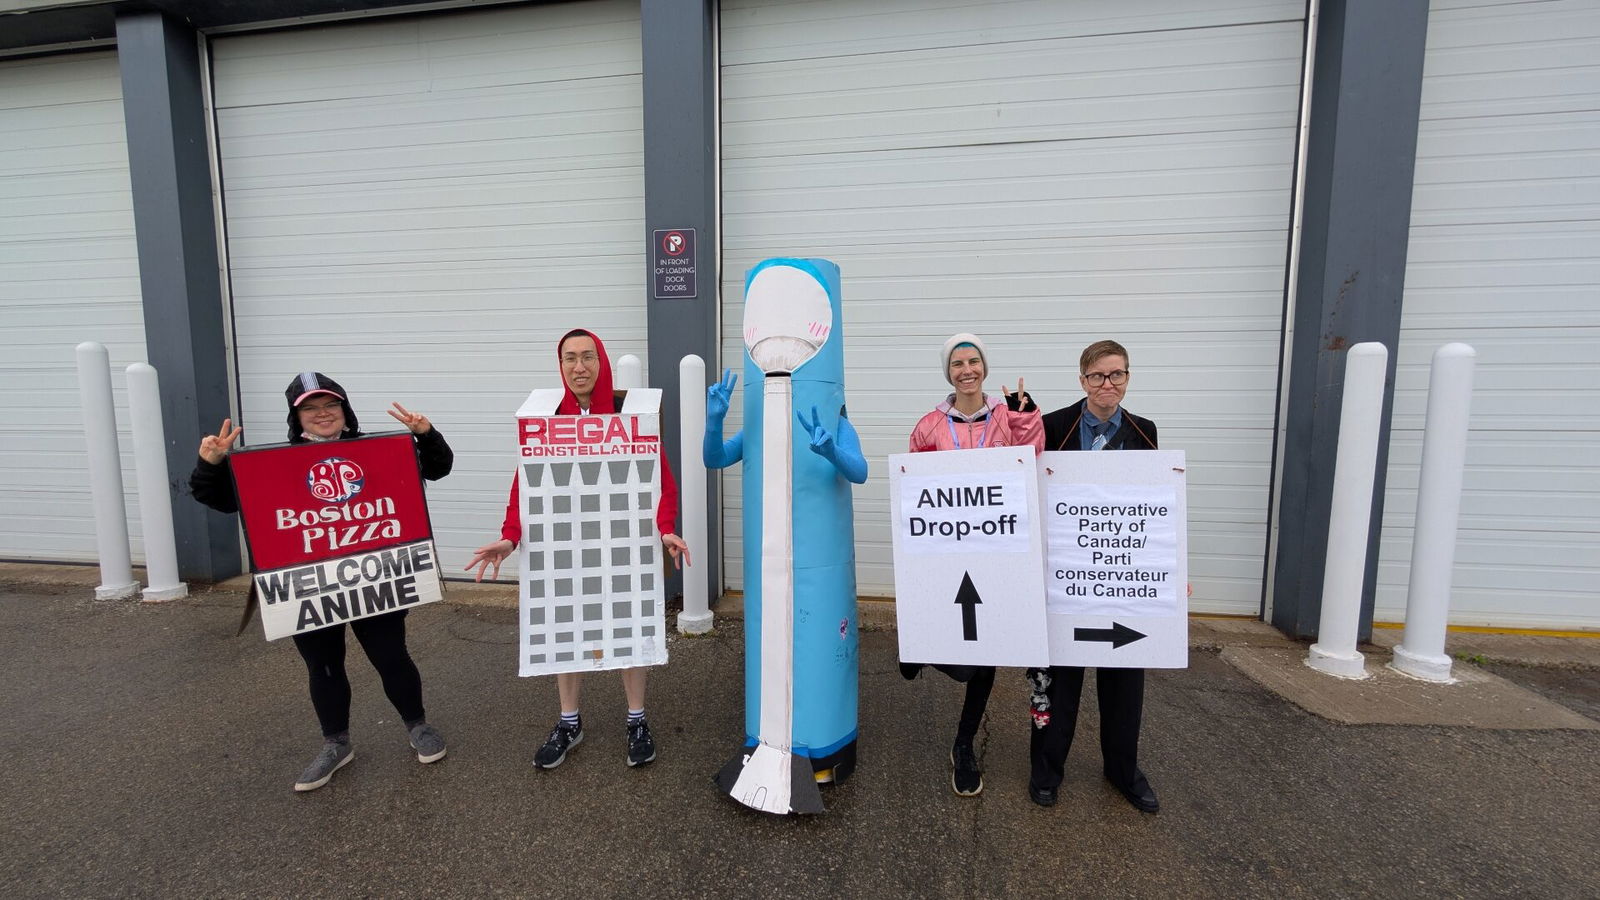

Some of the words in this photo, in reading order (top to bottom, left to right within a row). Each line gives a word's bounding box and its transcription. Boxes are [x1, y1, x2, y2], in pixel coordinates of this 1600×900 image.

[655, 267, 664, 275] OF
[665, 266, 695, 275] LOADING
[668, 258, 689, 266] FRONT
[663, 284, 687, 292] DOORS
[517, 416, 659, 446] REGAL
[521, 445, 658, 457] CONSTELLATION
[308, 458, 365, 502] BP
[916, 485, 1004, 509] ANIME
[276, 496, 396, 531] Boston
[1055, 502, 1168, 517] Conservative
[302, 517, 401, 554] Pizza
[909, 514, 1017, 541] Drop-off
[1079, 518, 1123, 536] Party
[1128, 519, 1146, 533] of
[1077, 535, 1147, 549] Canada/
[1092, 551, 1131, 566] Parti
[256, 542, 434, 606] WELCOME
[1055, 569, 1169, 582] conservateur
[1065, 582, 1087, 597] du
[1093, 583, 1158, 598] Canada
[296, 575, 420, 632] ANIME
